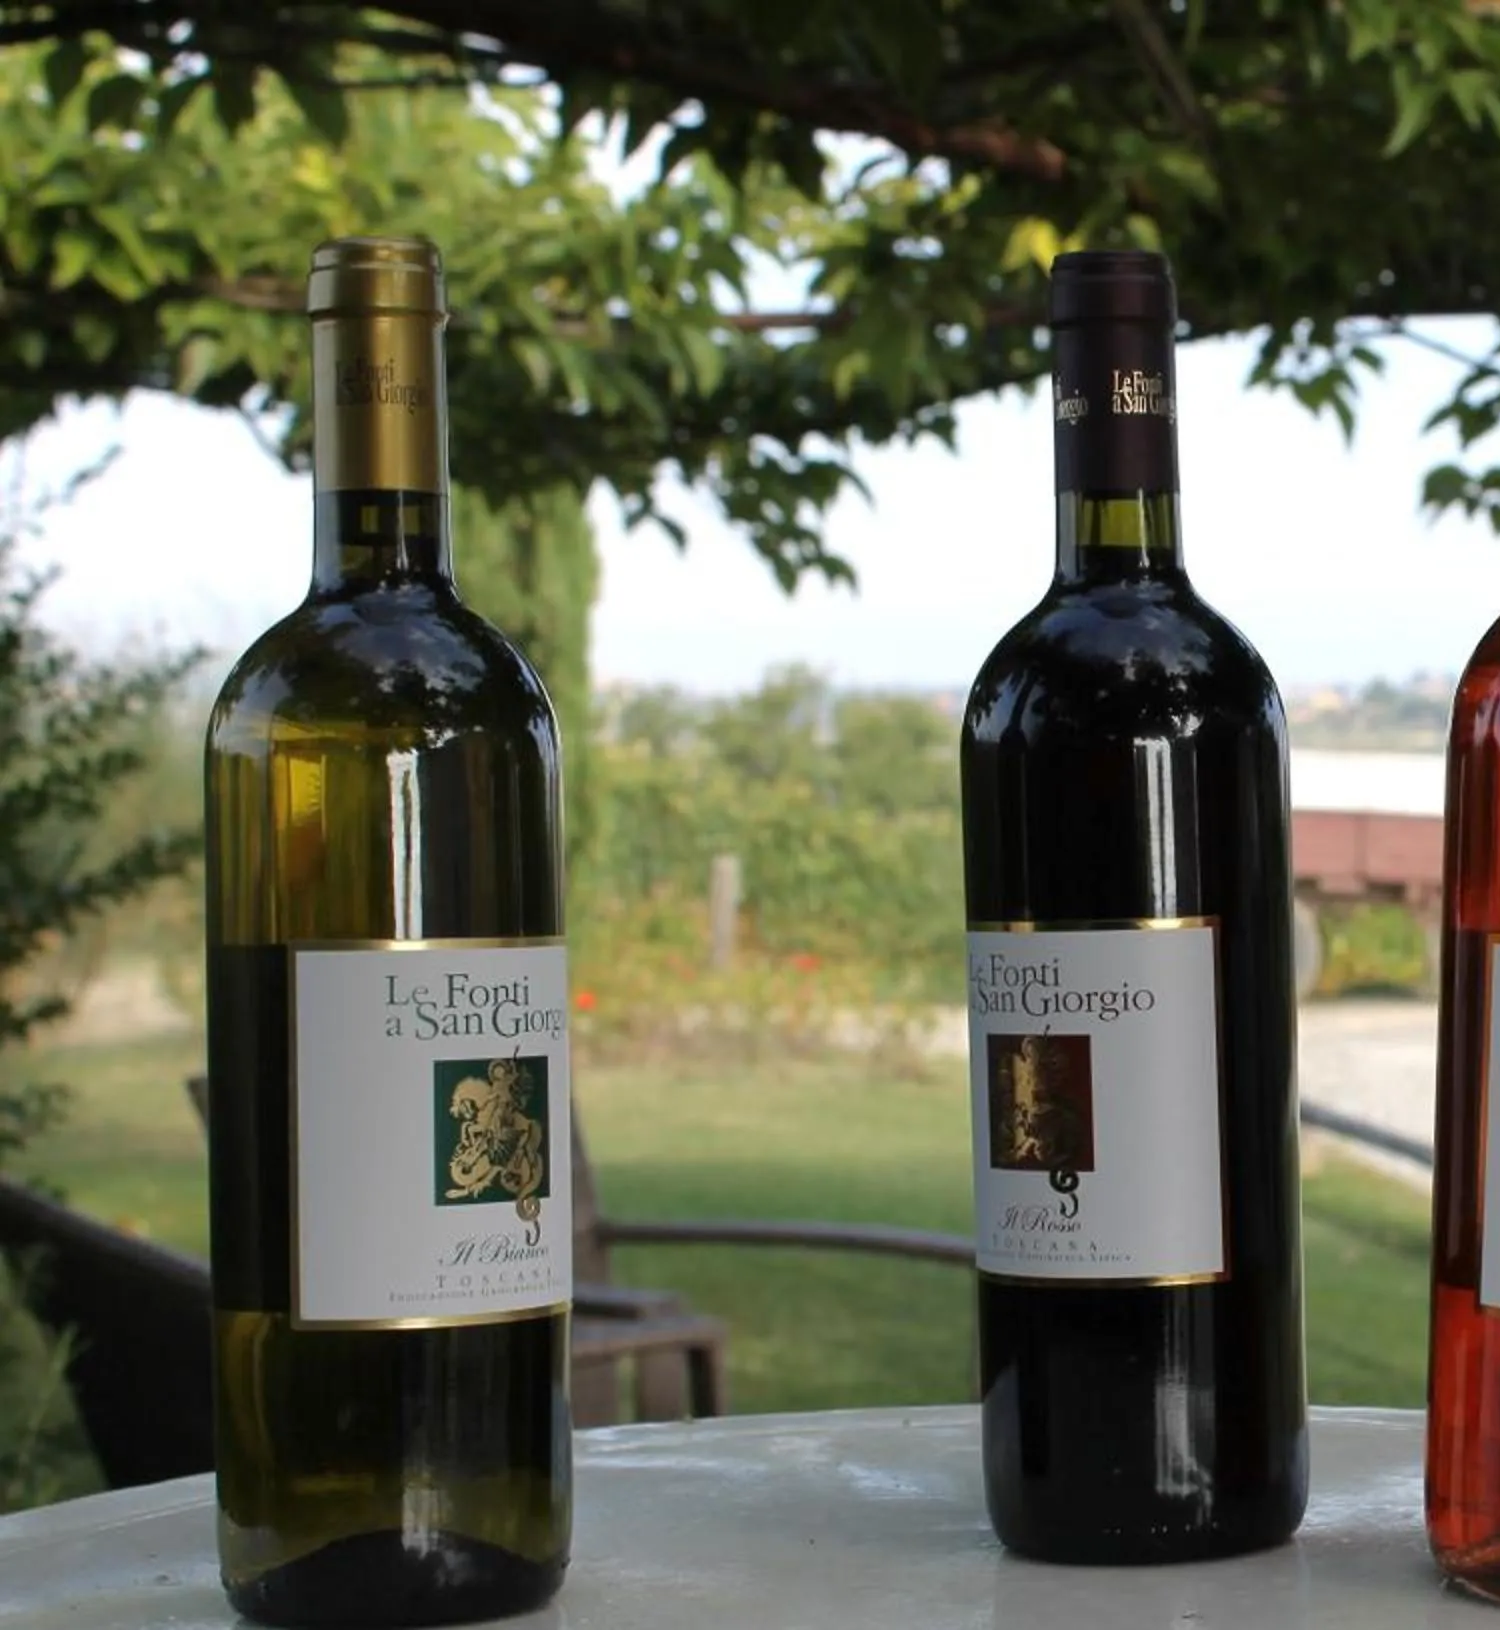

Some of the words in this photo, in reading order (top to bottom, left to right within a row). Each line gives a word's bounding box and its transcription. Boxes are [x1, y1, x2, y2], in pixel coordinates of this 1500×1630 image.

[1122, 388, 1148, 414] San
[989, 953, 1060, 987] Fonti
[384, 974, 430, 1006] Le
[443, 973, 530, 1009] Fonti
[977, 978, 1015, 1016] San
[1021, 980, 1155, 1022] Giorgio
[385, 1015, 403, 1037] a
[415, 1001, 484, 1041] San
[1019, 1205, 1082, 1233] Rosso
